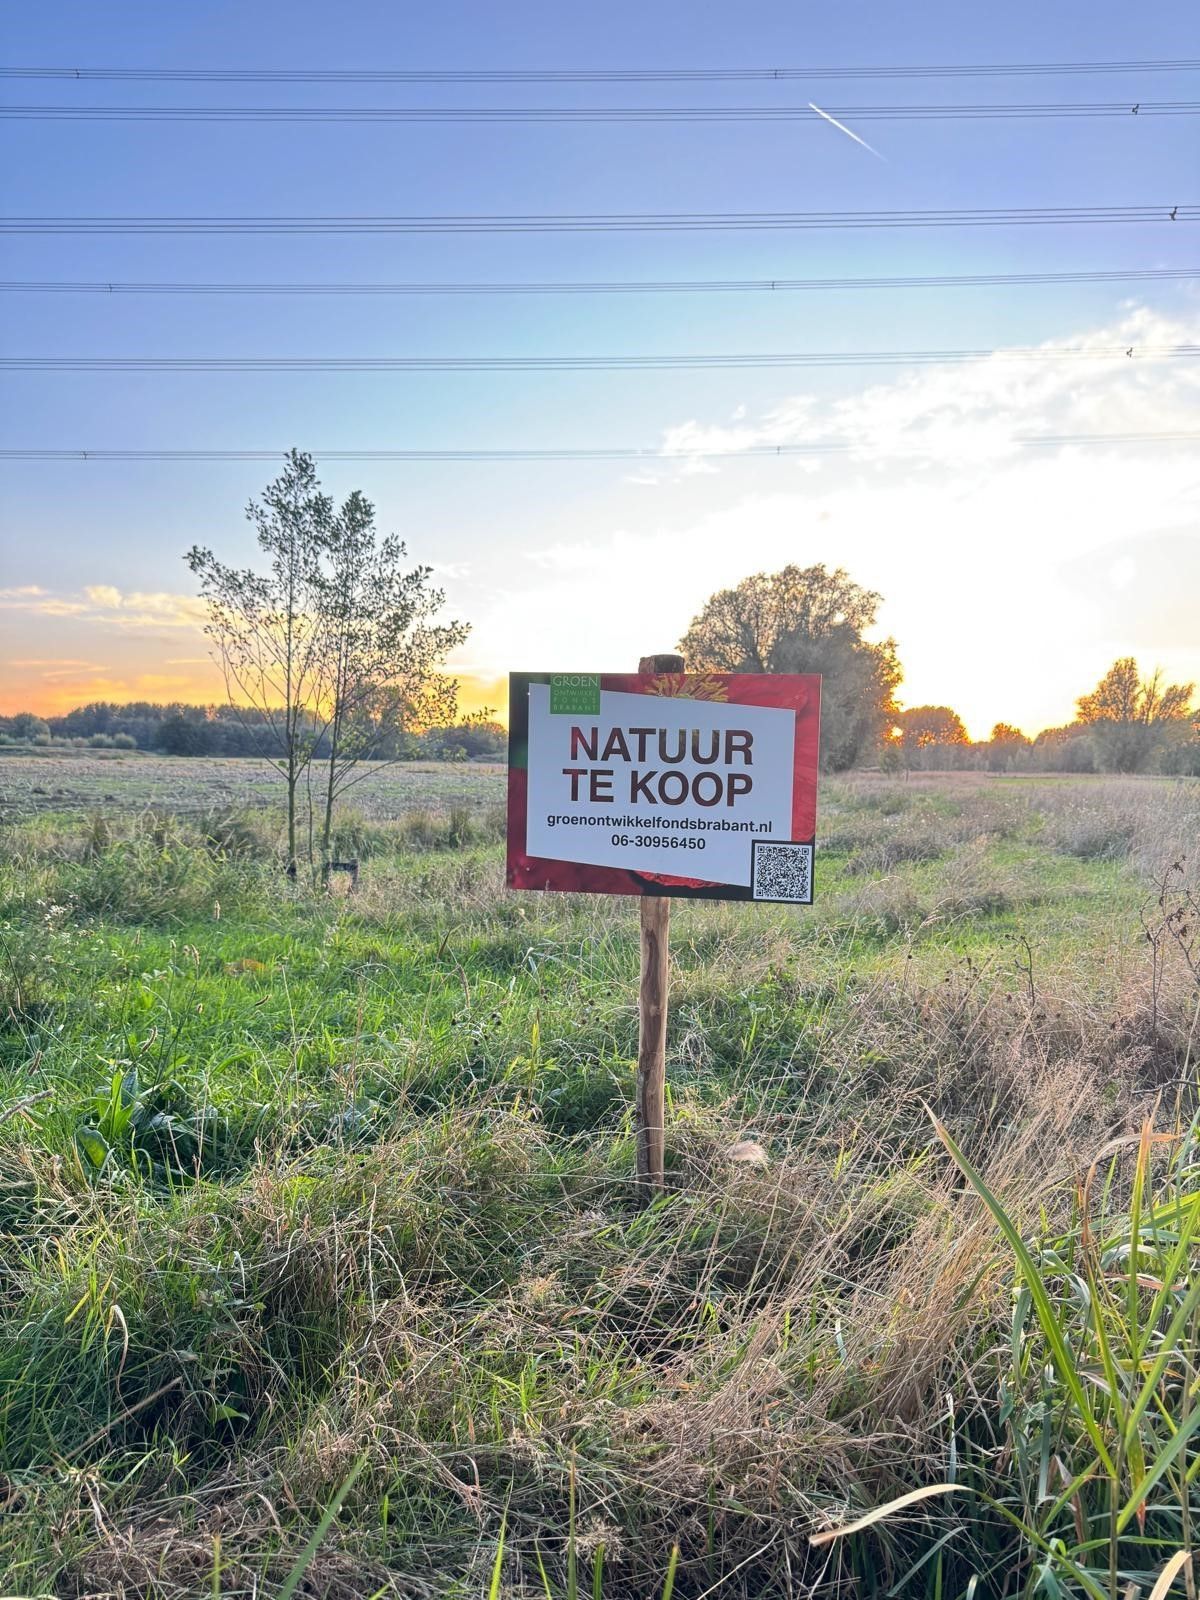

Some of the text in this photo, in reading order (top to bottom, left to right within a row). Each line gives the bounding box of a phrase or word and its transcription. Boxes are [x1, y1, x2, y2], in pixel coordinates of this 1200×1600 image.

[552, 675, 598, 687] GROEN
[570, 726, 754, 765] NATUUR
[562, 768, 753, 807] TE KOOP
[547, 813, 772, 833] groenontwikkelfondsbrabant.nl
[611, 834, 706, 850] 06-30956450
